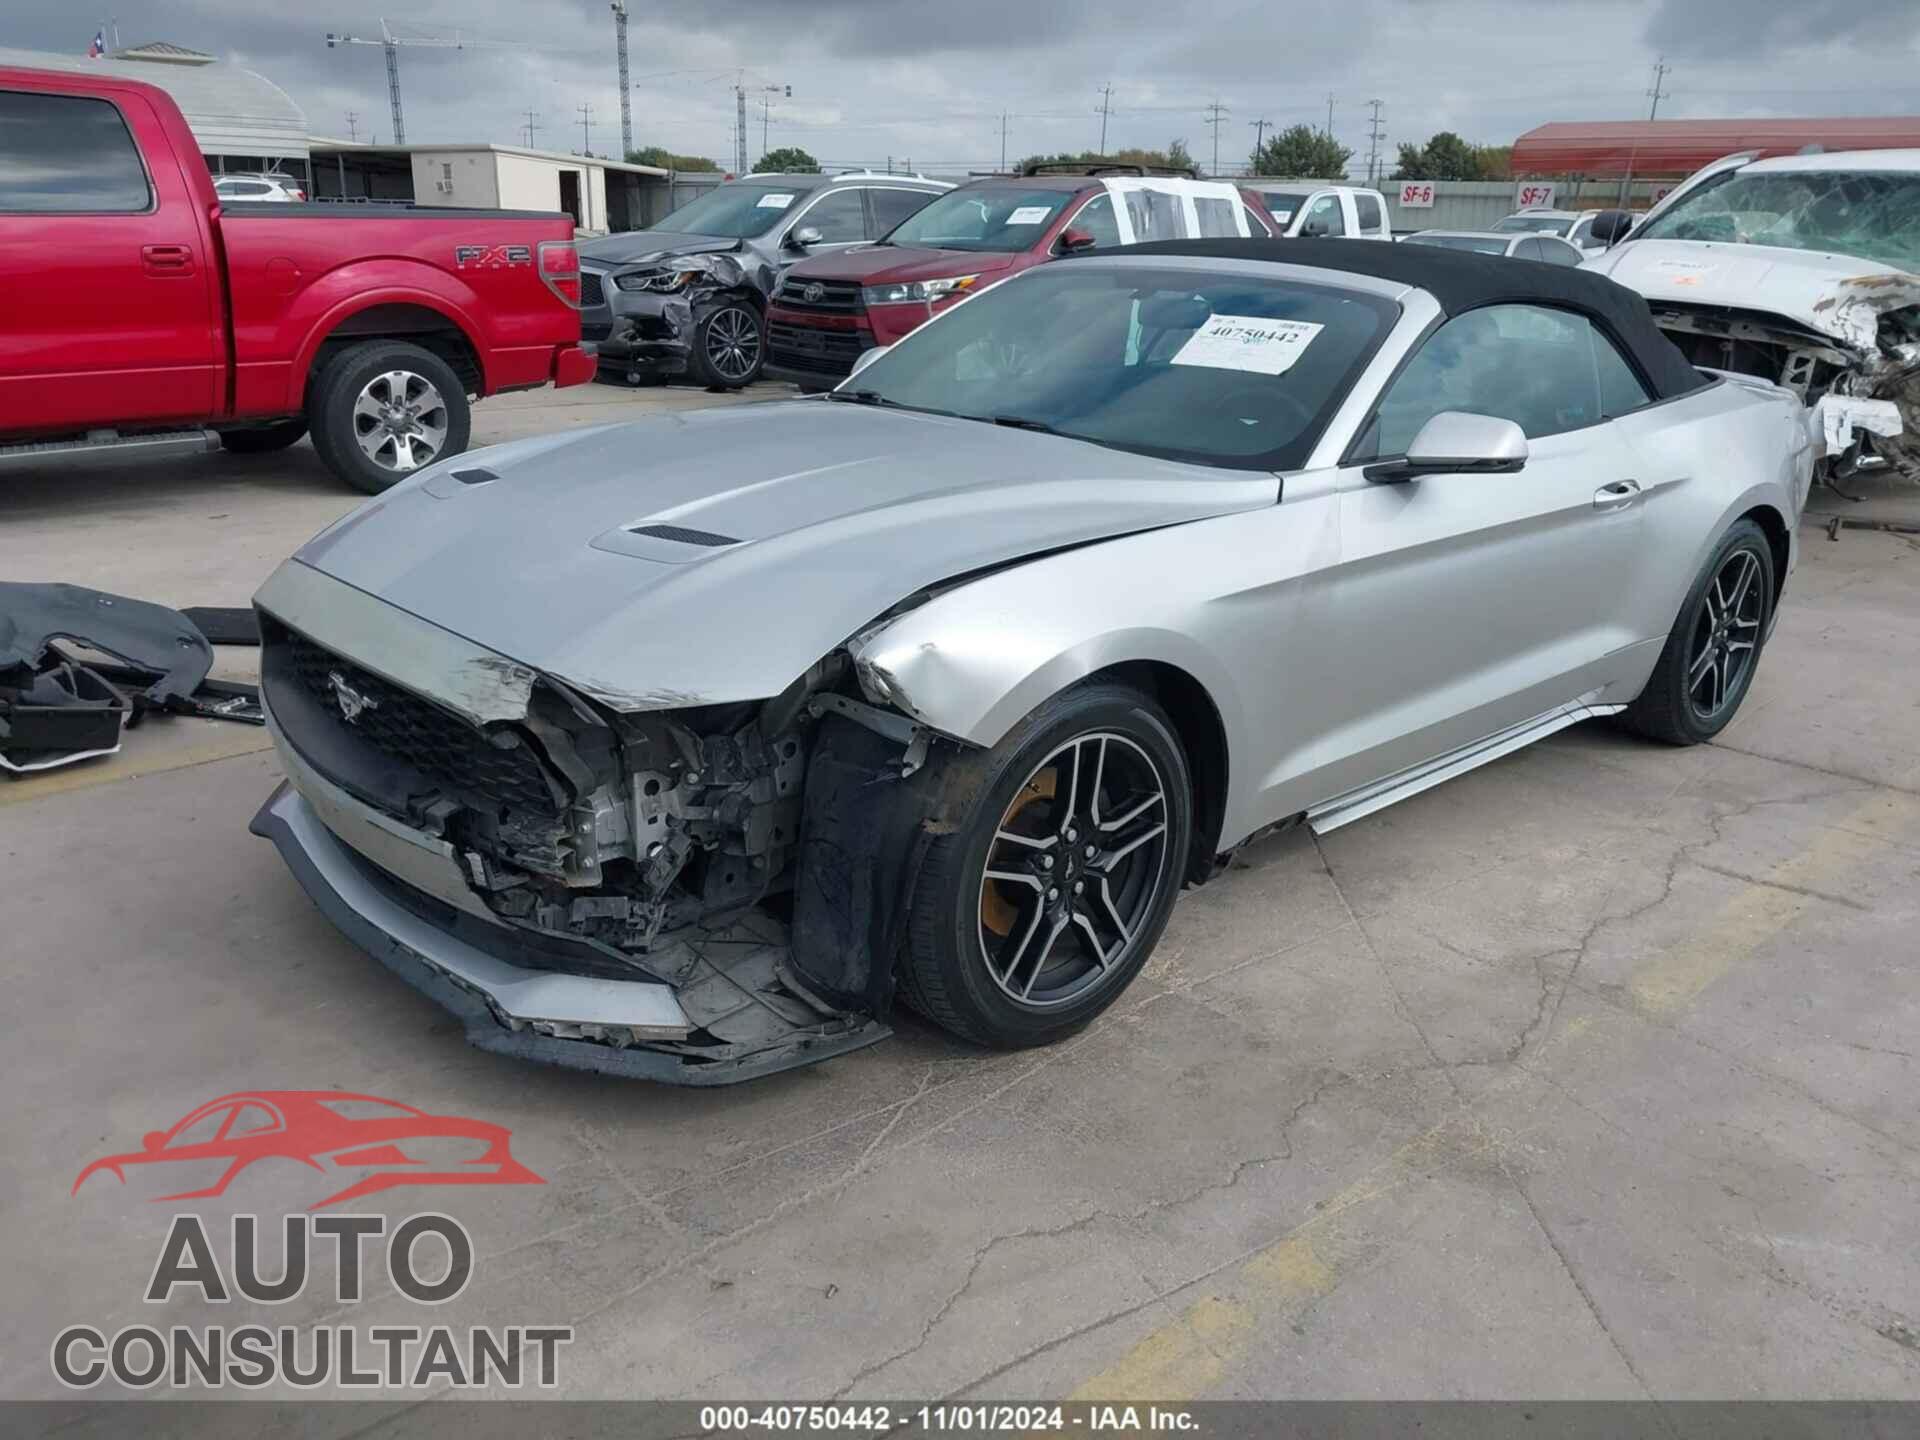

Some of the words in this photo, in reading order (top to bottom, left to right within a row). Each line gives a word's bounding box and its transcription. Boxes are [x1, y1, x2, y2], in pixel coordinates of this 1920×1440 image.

[1403, 185, 1431, 202] SF-6
[1521, 187, 1552, 204] SF-7
[1209, 326, 1299, 343] 40750442
